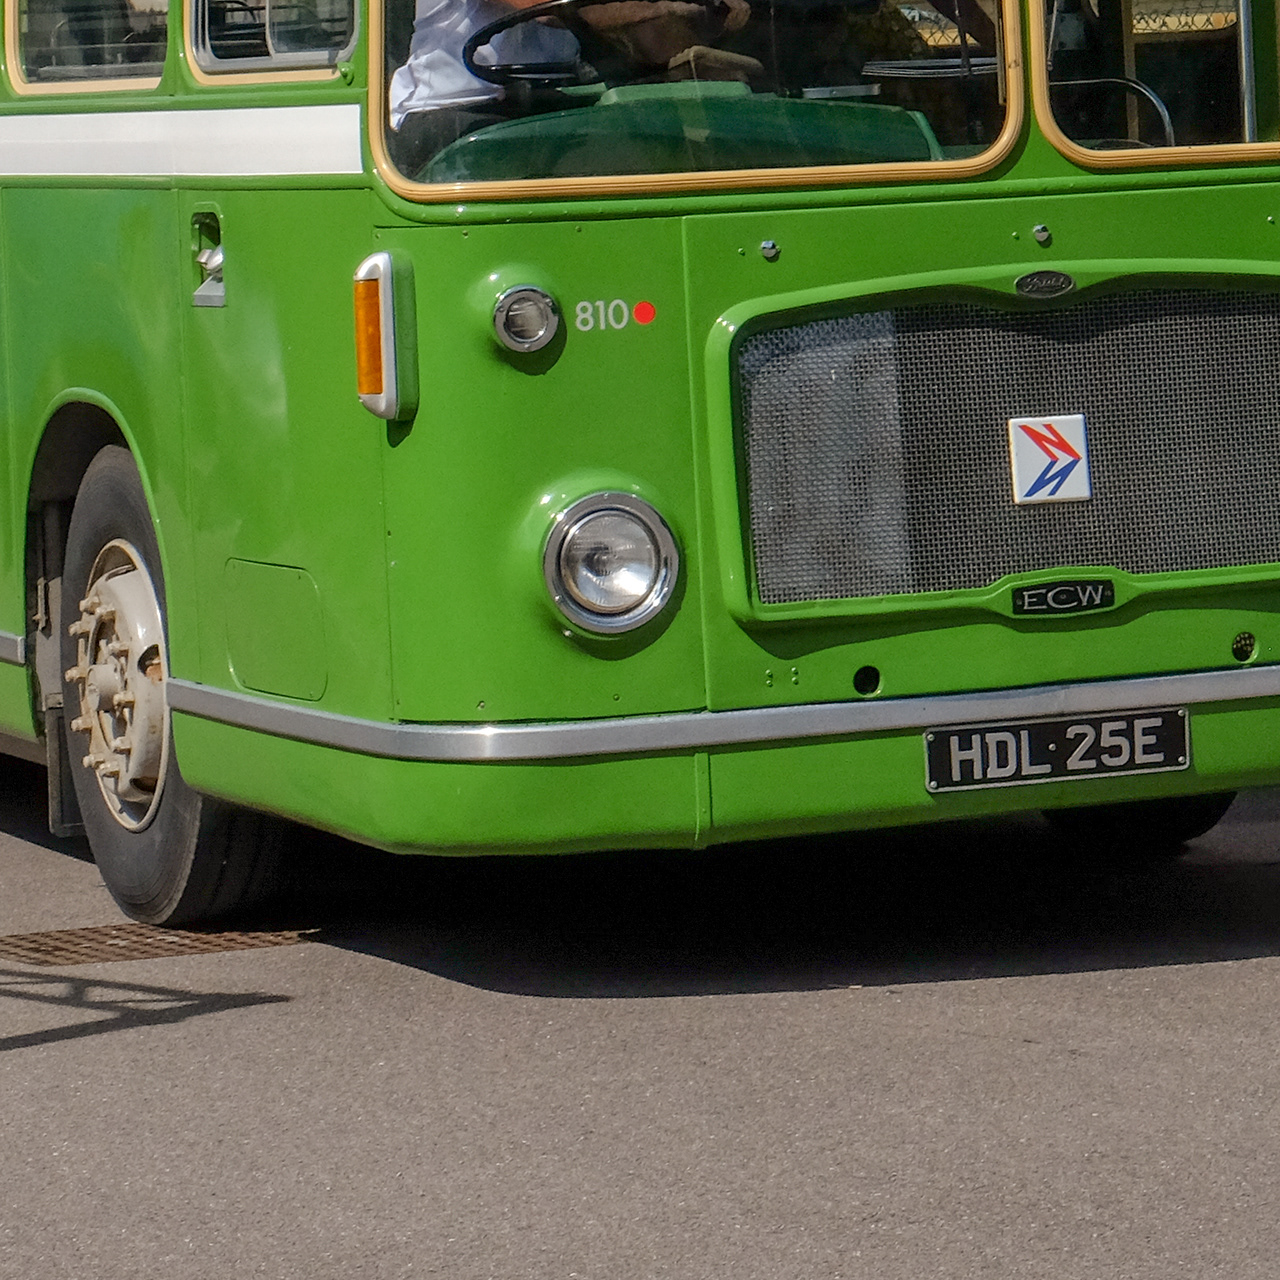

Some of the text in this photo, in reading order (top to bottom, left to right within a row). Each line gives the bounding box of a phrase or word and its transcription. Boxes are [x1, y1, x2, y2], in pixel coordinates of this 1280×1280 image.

[575, 299, 630, 331] 810
[1022, 585, 1103, 610] ECW
[949, 717, 1165, 782] HDL 25E
